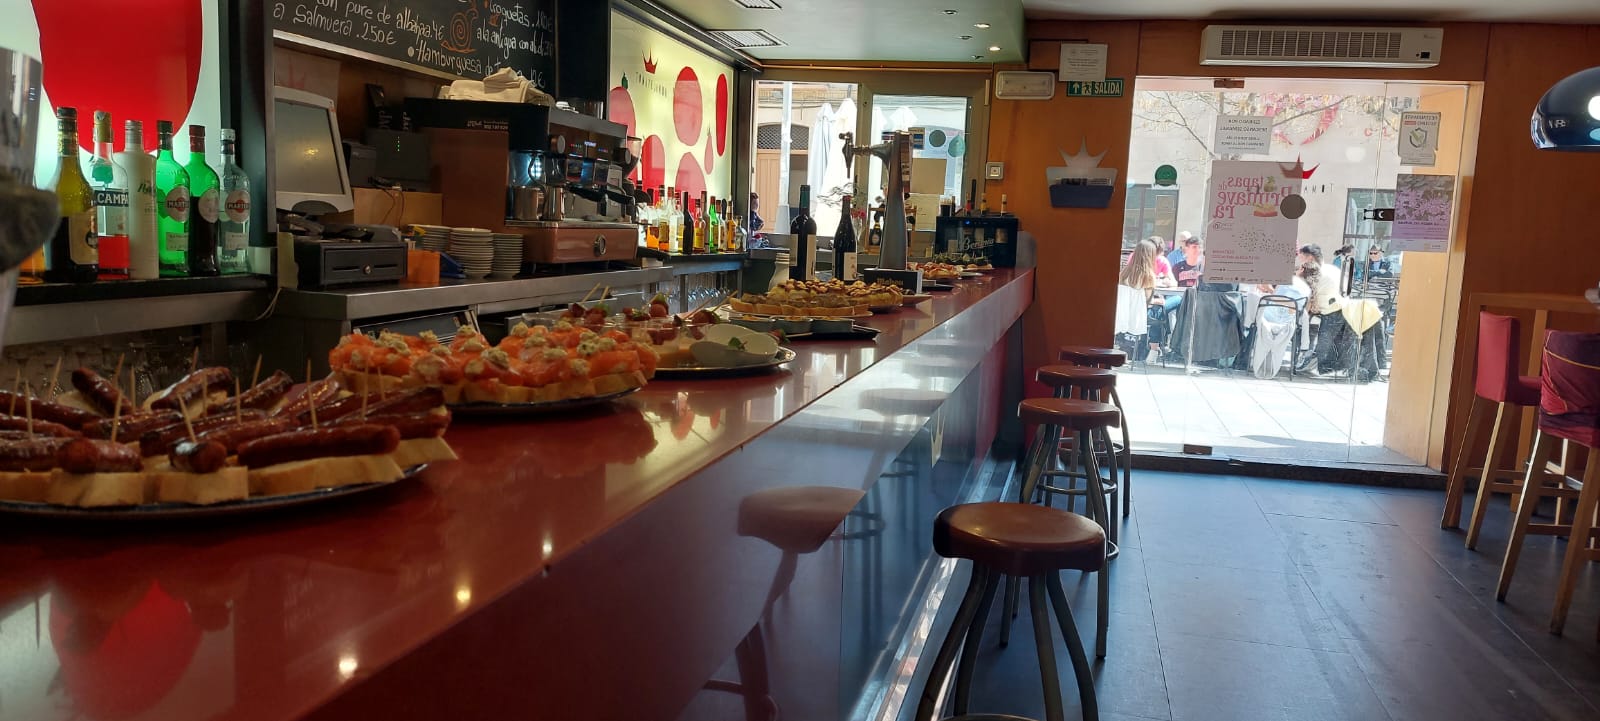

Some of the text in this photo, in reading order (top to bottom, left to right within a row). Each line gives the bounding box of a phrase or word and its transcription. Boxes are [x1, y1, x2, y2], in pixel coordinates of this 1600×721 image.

[293, 4, 353, 36] Salmuera
[345, 2, 373, 18] pure
[377, 4, 391, 24] de
[416, 39, 482, 76] Hamburguesa
[1094, 81, 1120, 94] SALIDA
[97, 192, 129, 204] CAMPA
